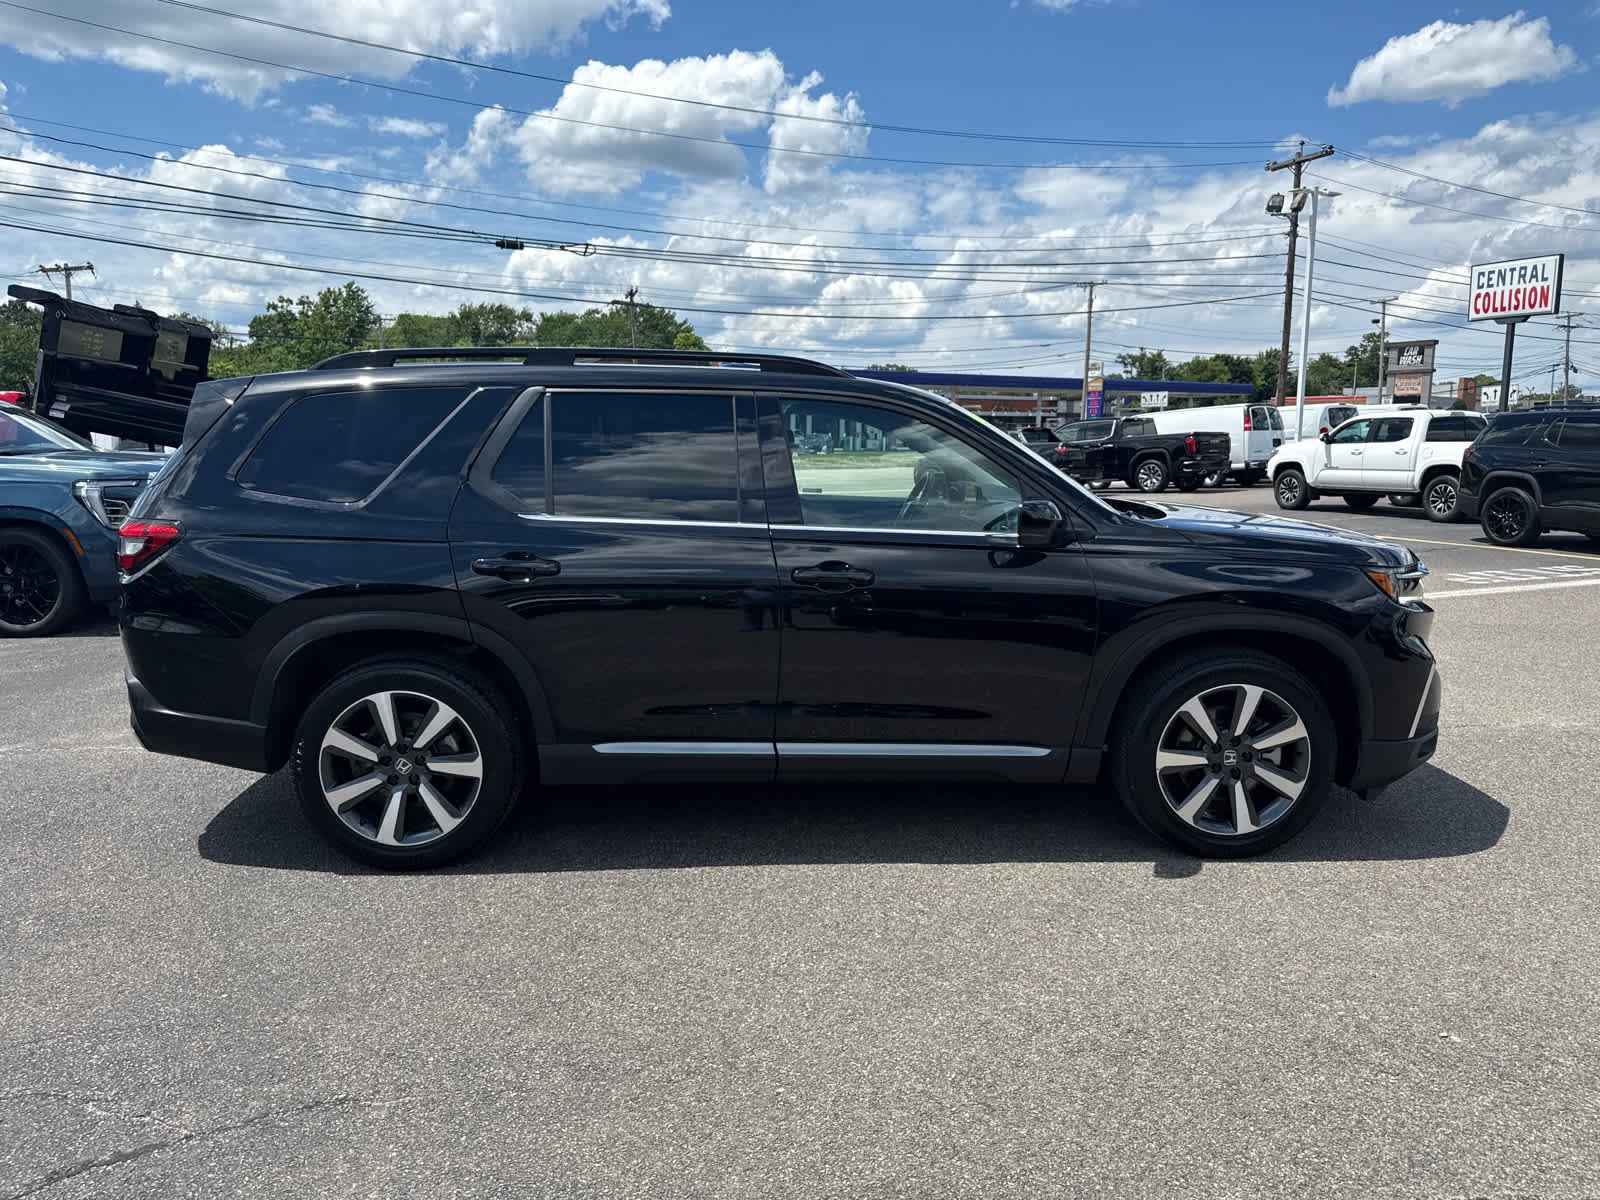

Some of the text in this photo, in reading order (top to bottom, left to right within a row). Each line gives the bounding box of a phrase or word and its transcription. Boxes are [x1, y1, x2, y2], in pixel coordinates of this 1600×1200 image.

[1476, 263, 1549, 290] CENTRAL
[1473, 285, 1550, 315] COLLISION
[1399, 354, 1423, 365] WASH
[1403, 345, 1419, 356] CAR
